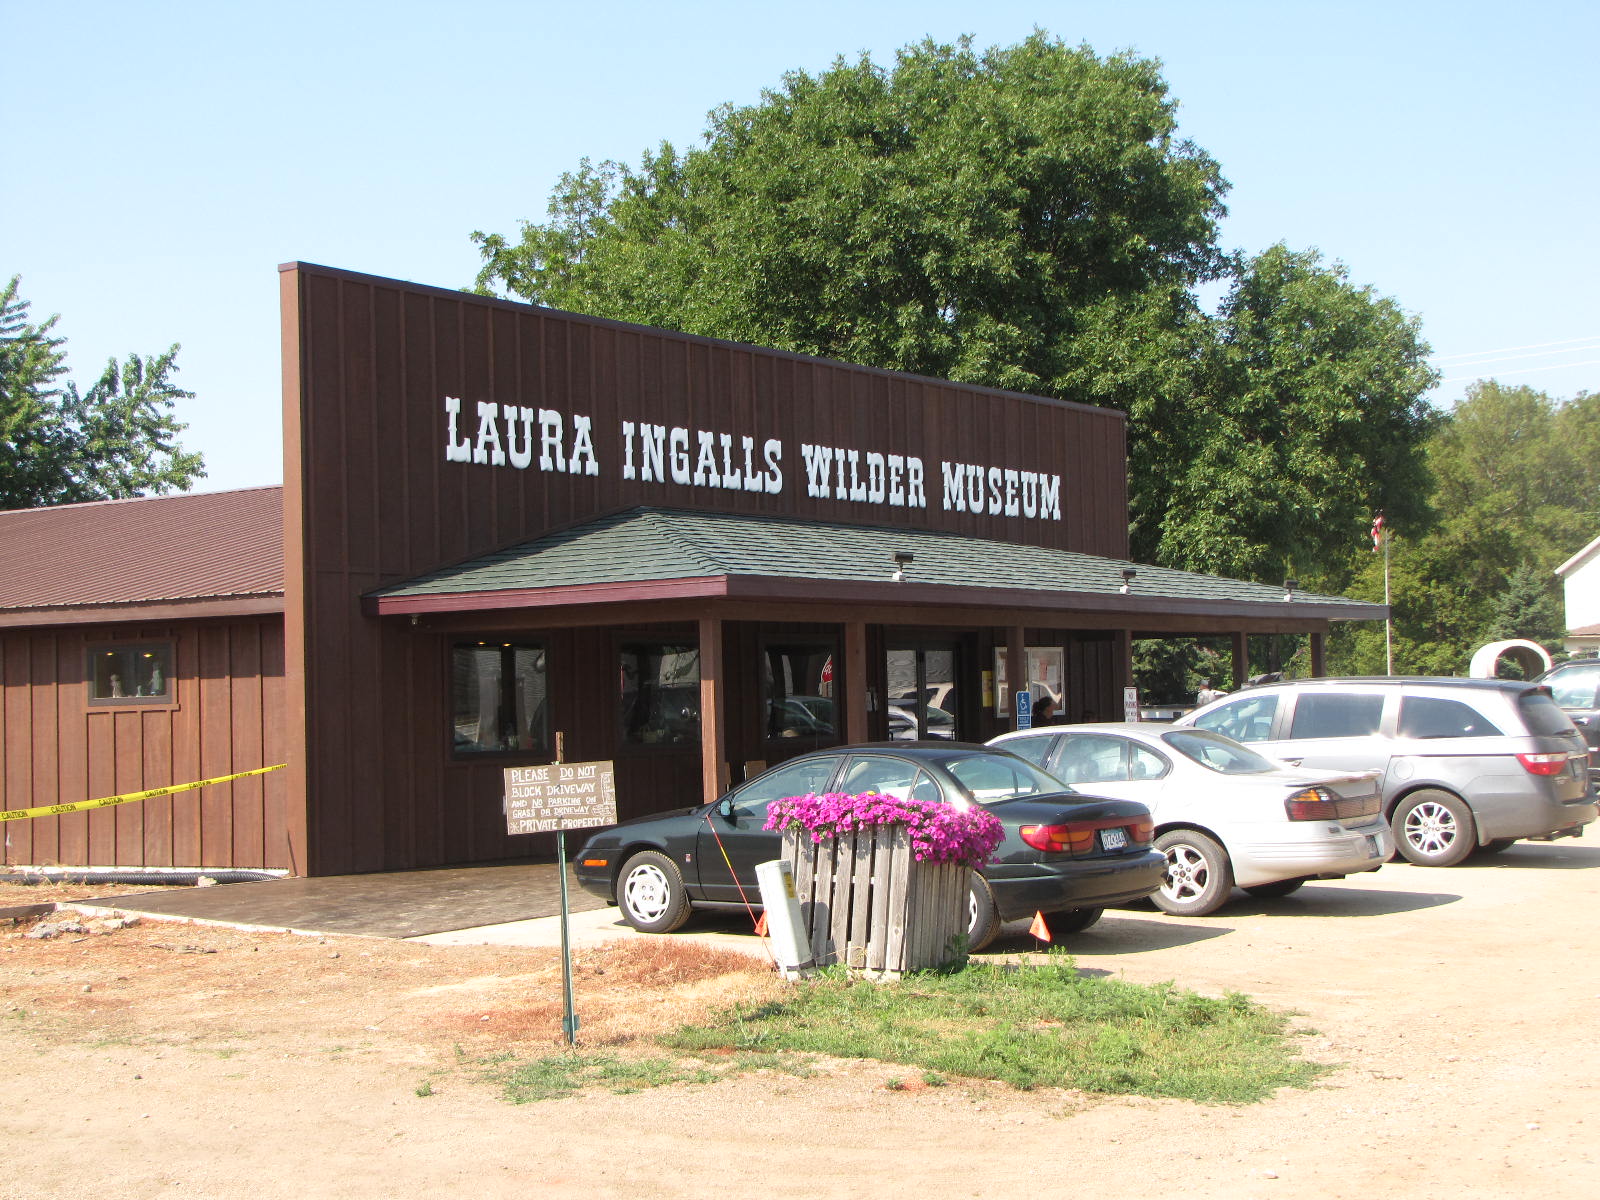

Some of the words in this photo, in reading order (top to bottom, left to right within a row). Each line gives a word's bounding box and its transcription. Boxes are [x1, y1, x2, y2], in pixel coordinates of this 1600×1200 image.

[445, 396, 599, 476] LAURA
[622, 420, 783, 494] INGALLS
[801, 443, 927, 508] WILDER
[941, 461, 1061, 521] MUSEUM
[511, 768, 549, 783] PLEASE
[560, 767, 574, 778] DO
[577, 765, 597, 777] NOT
[511, 785, 542, 798] BLOCK
[546, 783, 596, 796] DRIVEWAY
[98, 797, 124, 807] CAUTION
[511, 799, 528, 809] AND
[548, 797, 581, 807] PARKING
[1, 810, 28, 820] CAUTION
[50, 804, 77, 814] CAUTION
[512, 809, 536, 819] GRASS
[540, 808, 551, 816] OR
[519, 818, 558, 832] PRIVATE
[561, 816, 606, 829] PROPERTY
